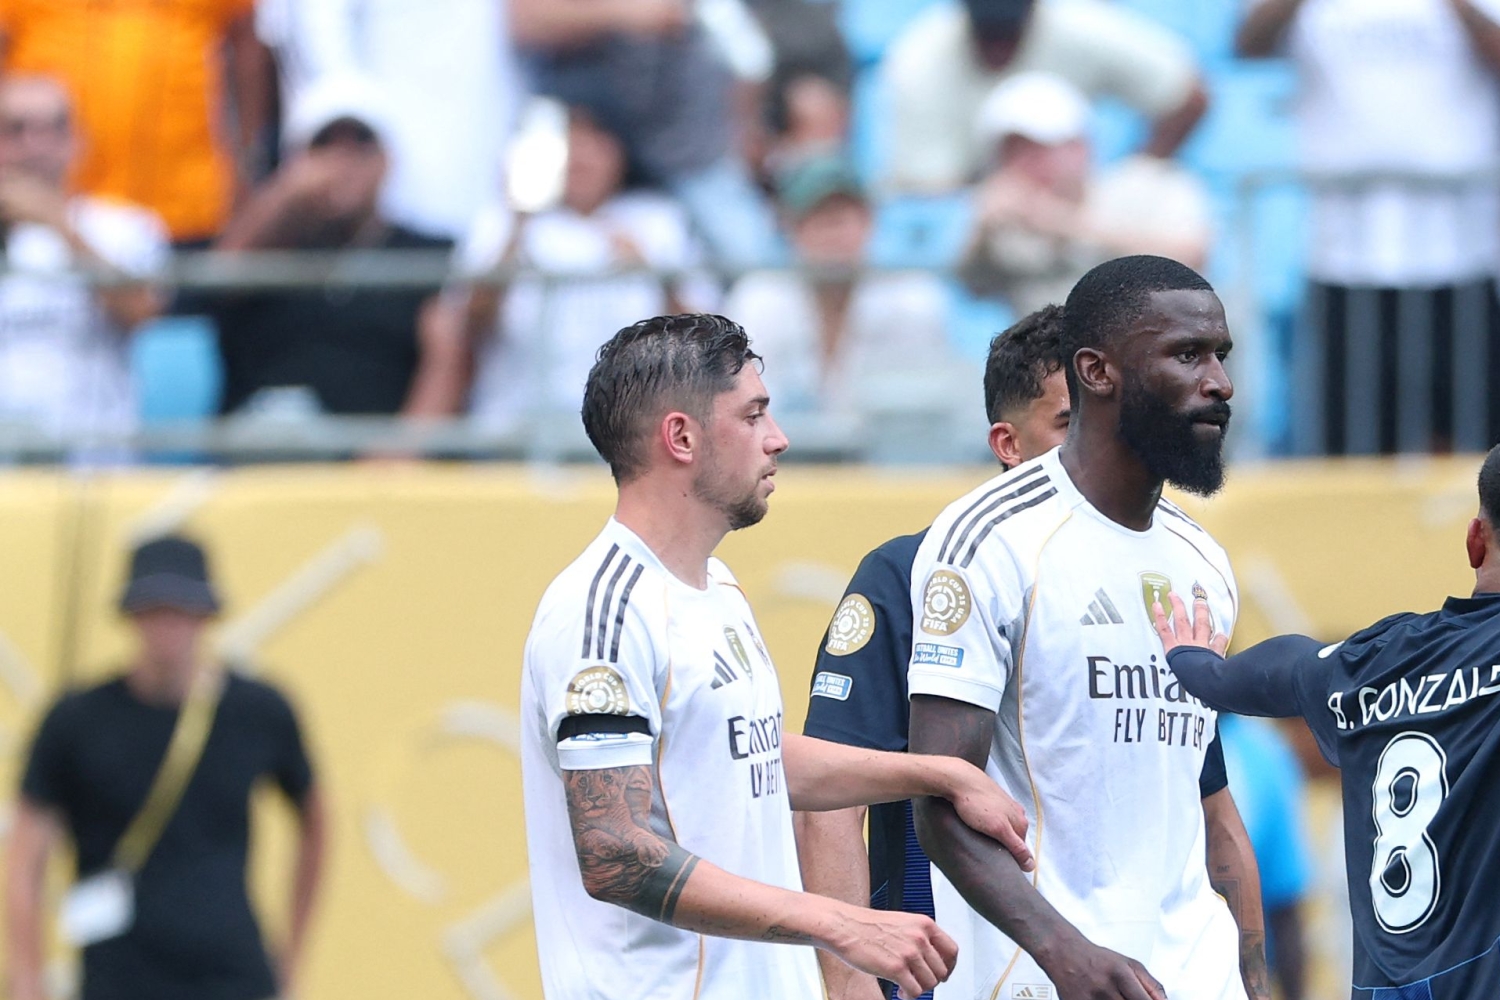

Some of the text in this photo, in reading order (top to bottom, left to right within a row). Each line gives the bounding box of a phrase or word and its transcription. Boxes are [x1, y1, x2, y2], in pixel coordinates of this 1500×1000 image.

[923, 618, 948, 632] FIFA
[828, 639, 848, 651] FIFA
[1114, 708, 1146, 743] FLY
[1369, 731, 1450, 934] 8
